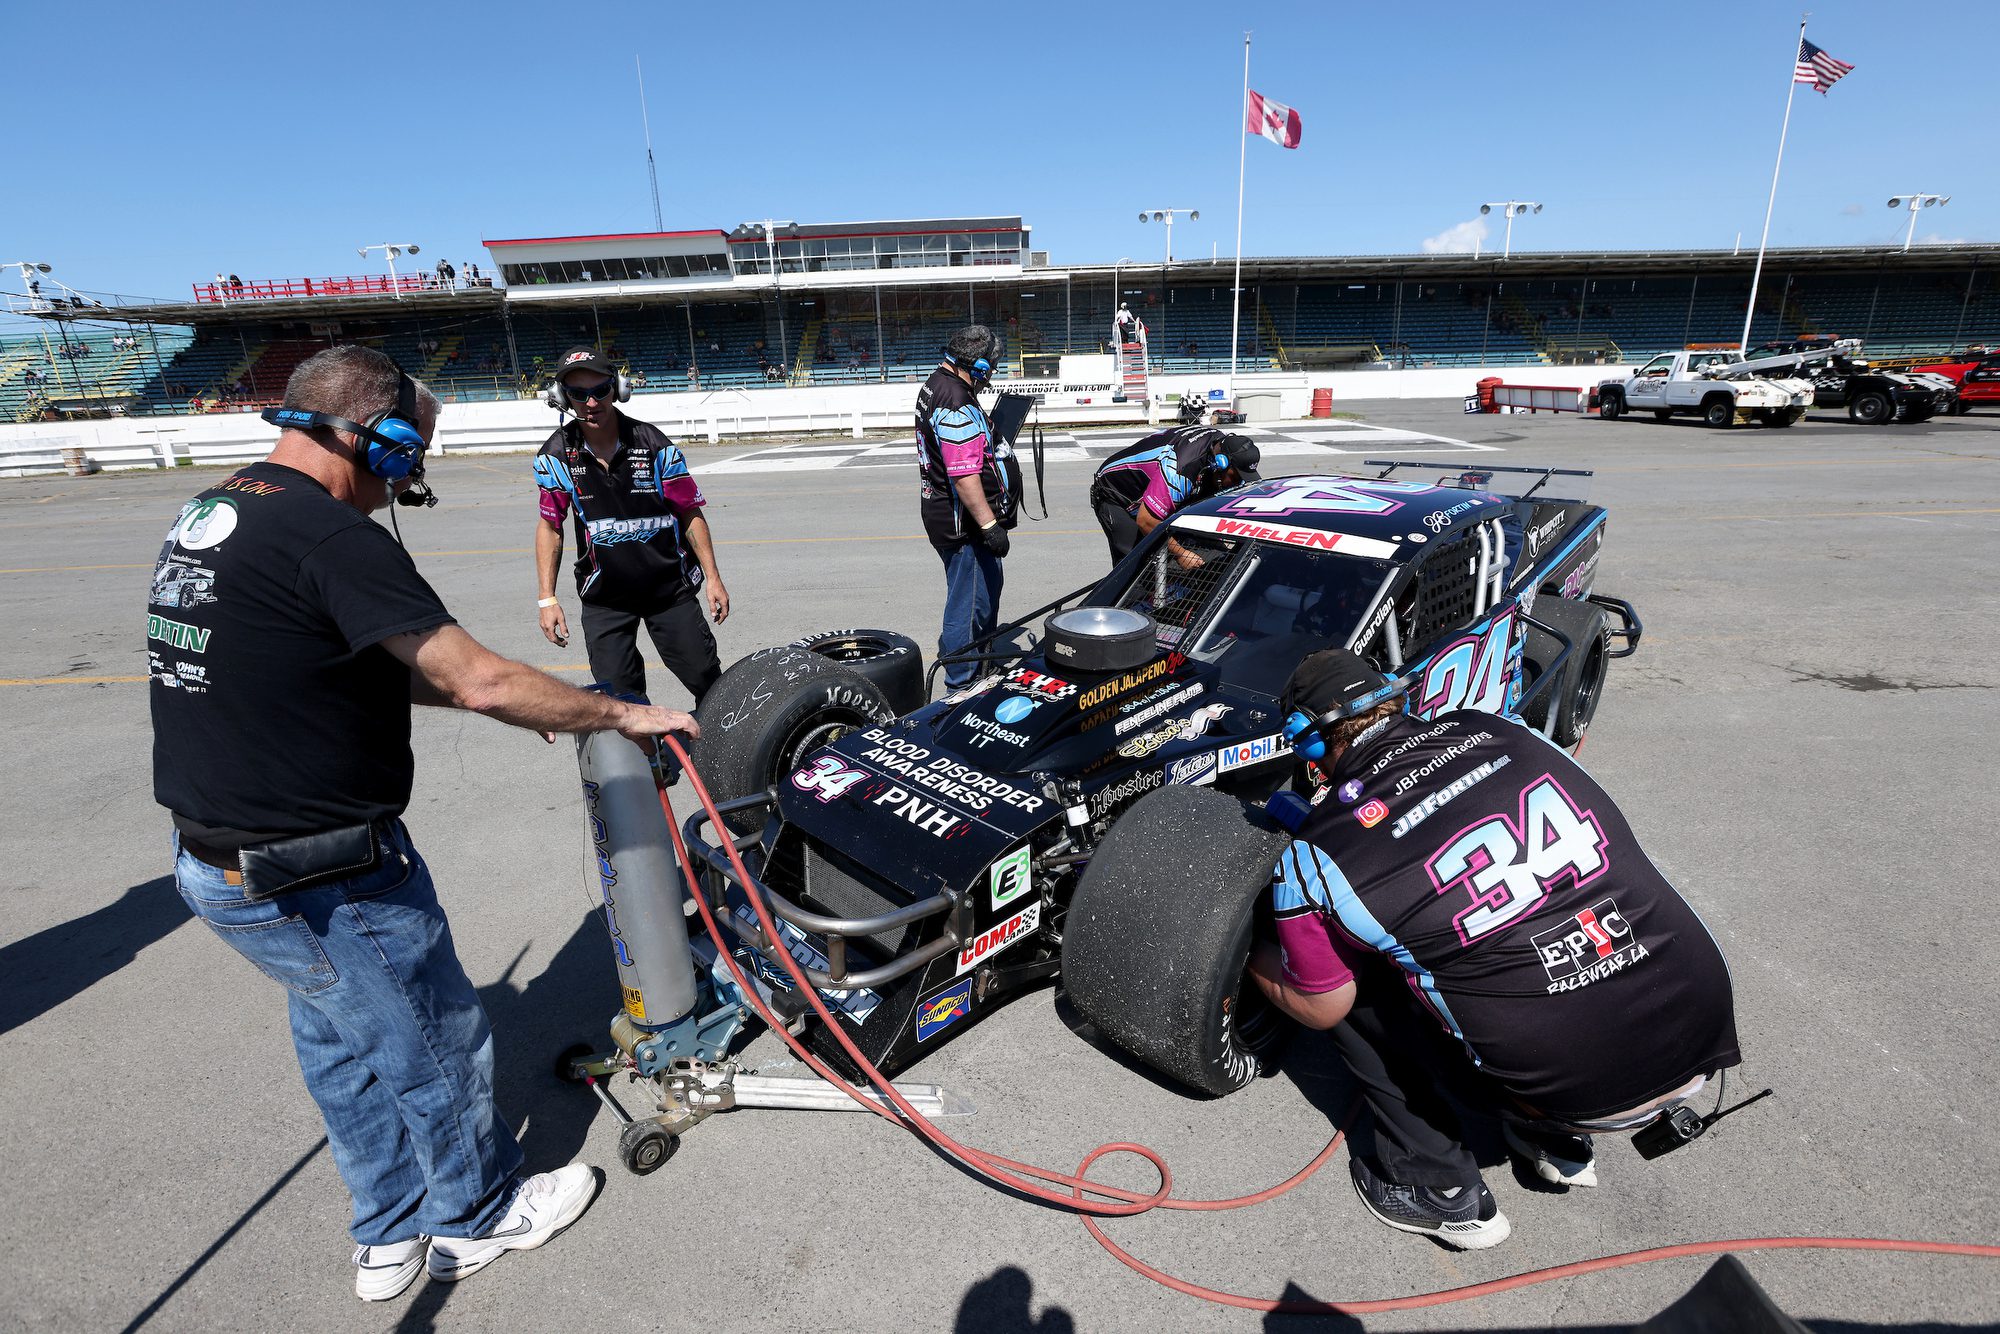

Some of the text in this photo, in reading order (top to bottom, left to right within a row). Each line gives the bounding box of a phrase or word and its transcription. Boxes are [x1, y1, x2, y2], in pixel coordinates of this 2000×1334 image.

[1215, 518, 1344, 550] WHELEN
[147, 613, 211, 654] ORTIN
[1353, 596, 1395, 656] Guardian
[1079, 678, 1119, 711] GOLDEN
[1119, 659, 1167, 692] JALAPENO
[960, 712, 1031, 748] Northeast
[968, 733, 996, 749] IT
[1223, 737, 1271, 767] Mobil
[791, 755, 872, 804] 34
[860, 728, 1044, 814] BLOOD DISORDER
[860, 747, 994, 811] AWARENESS
[1394, 730, 1493, 797] JBFortinRacing
[872, 785, 963, 839] PNH
[1091, 770, 1164, 818] Hoosier
[1424, 772, 1610, 948] 34
[961, 915, 1023, 967] COMP
[1003, 922, 1032, 945] CAMS
[1539, 910, 1629, 968] EPIC
[1546, 943, 1650, 995] RACEWEAR.CA
[920, 992, 968, 1026] SUNOCO
